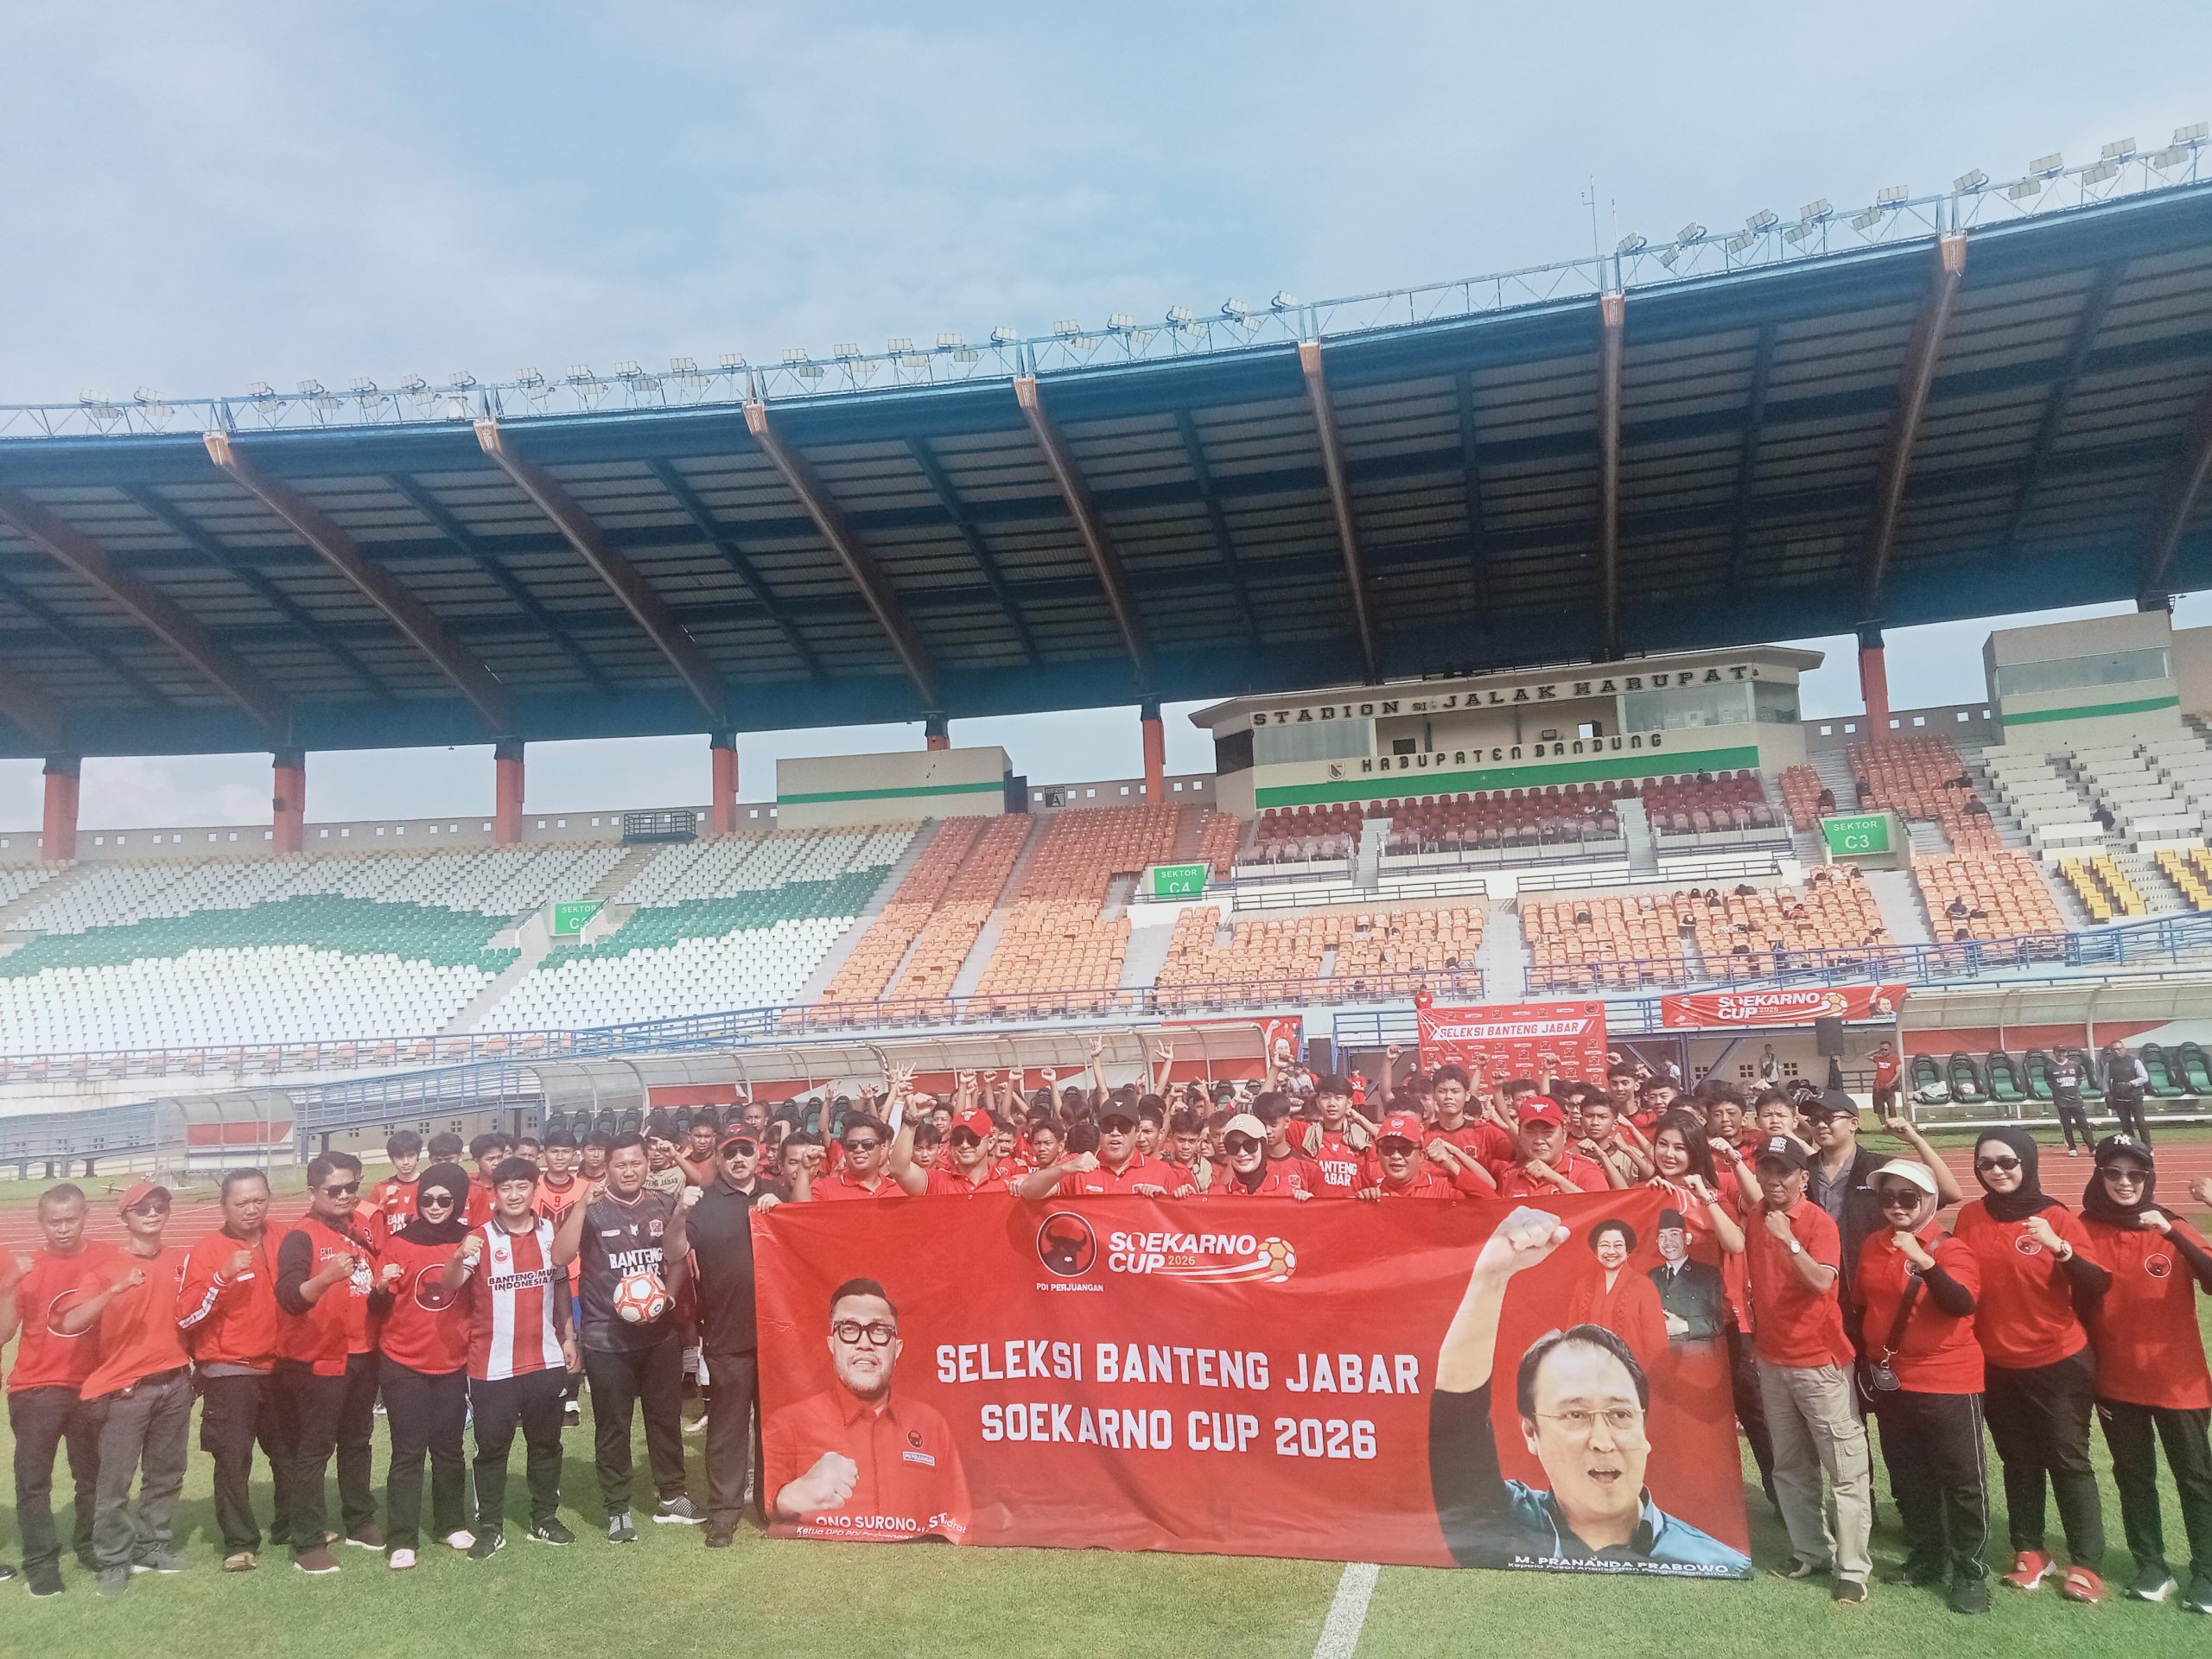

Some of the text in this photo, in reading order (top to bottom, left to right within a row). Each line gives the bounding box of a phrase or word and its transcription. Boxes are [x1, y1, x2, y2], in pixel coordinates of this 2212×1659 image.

[1253, 701, 1399, 725] STADION
[1443, 685, 1555, 709] JALAK
[1574, 666, 1747, 696] HARUPAT
[1535, 734, 1662, 758] BANDUNG
[1834, 821, 1878, 831] SEKTOR
[1845, 835, 1870, 849] C3
[1161, 869, 1197, 878] SEKTOR
[1169, 881, 1191, 893] C4
[1718, 992, 1821, 1007] SOEKARNO
[1718, 1007, 1758, 1020] CUP
[1440, 1023, 1579, 1037] SELEKSI BANTENG JABAR
[1108, 1232, 1256, 1254] SOEKARNO
[608, 1248, 663, 1269] BANTENG
[1108, 1253, 1196, 1274] CUP 2026
[489, 1272, 534, 1285] BANTENG
[494, 1277, 548, 1293] INDONESIA
[1051, 1283, 1104, 1293] PERJUANGAN
[936, 1340, 1420, 1394] SELEKSI BANTENG JABAR
[981, 1402, 1377, 1459] SOEKARNO CUP 2026
[816, 1516, 852, 1529] ONO
[1516, 1555, 1729, 1573] M. PRANANDA PRABOWO
